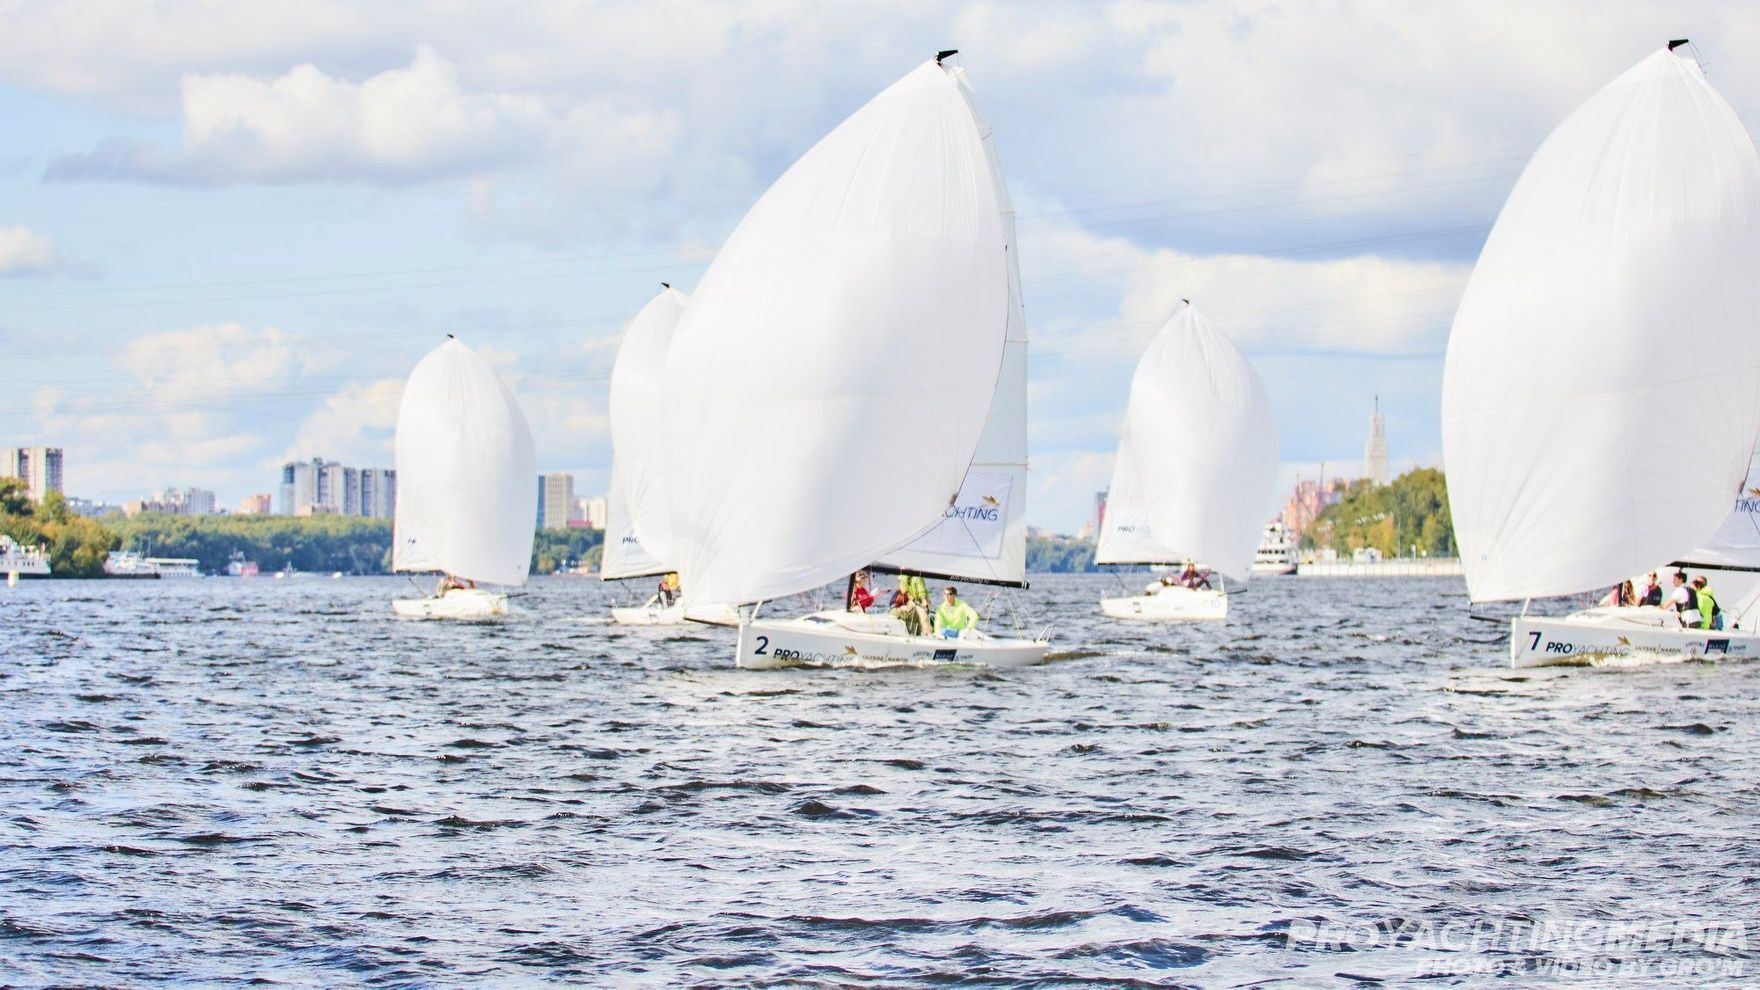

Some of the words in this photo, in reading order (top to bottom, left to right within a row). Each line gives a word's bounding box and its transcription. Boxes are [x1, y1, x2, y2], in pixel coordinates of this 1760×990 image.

[943, 506, 998, 521] CHTING
[754, 636, 769, 655] 2
[1529, 631, 1542, 651] 7
